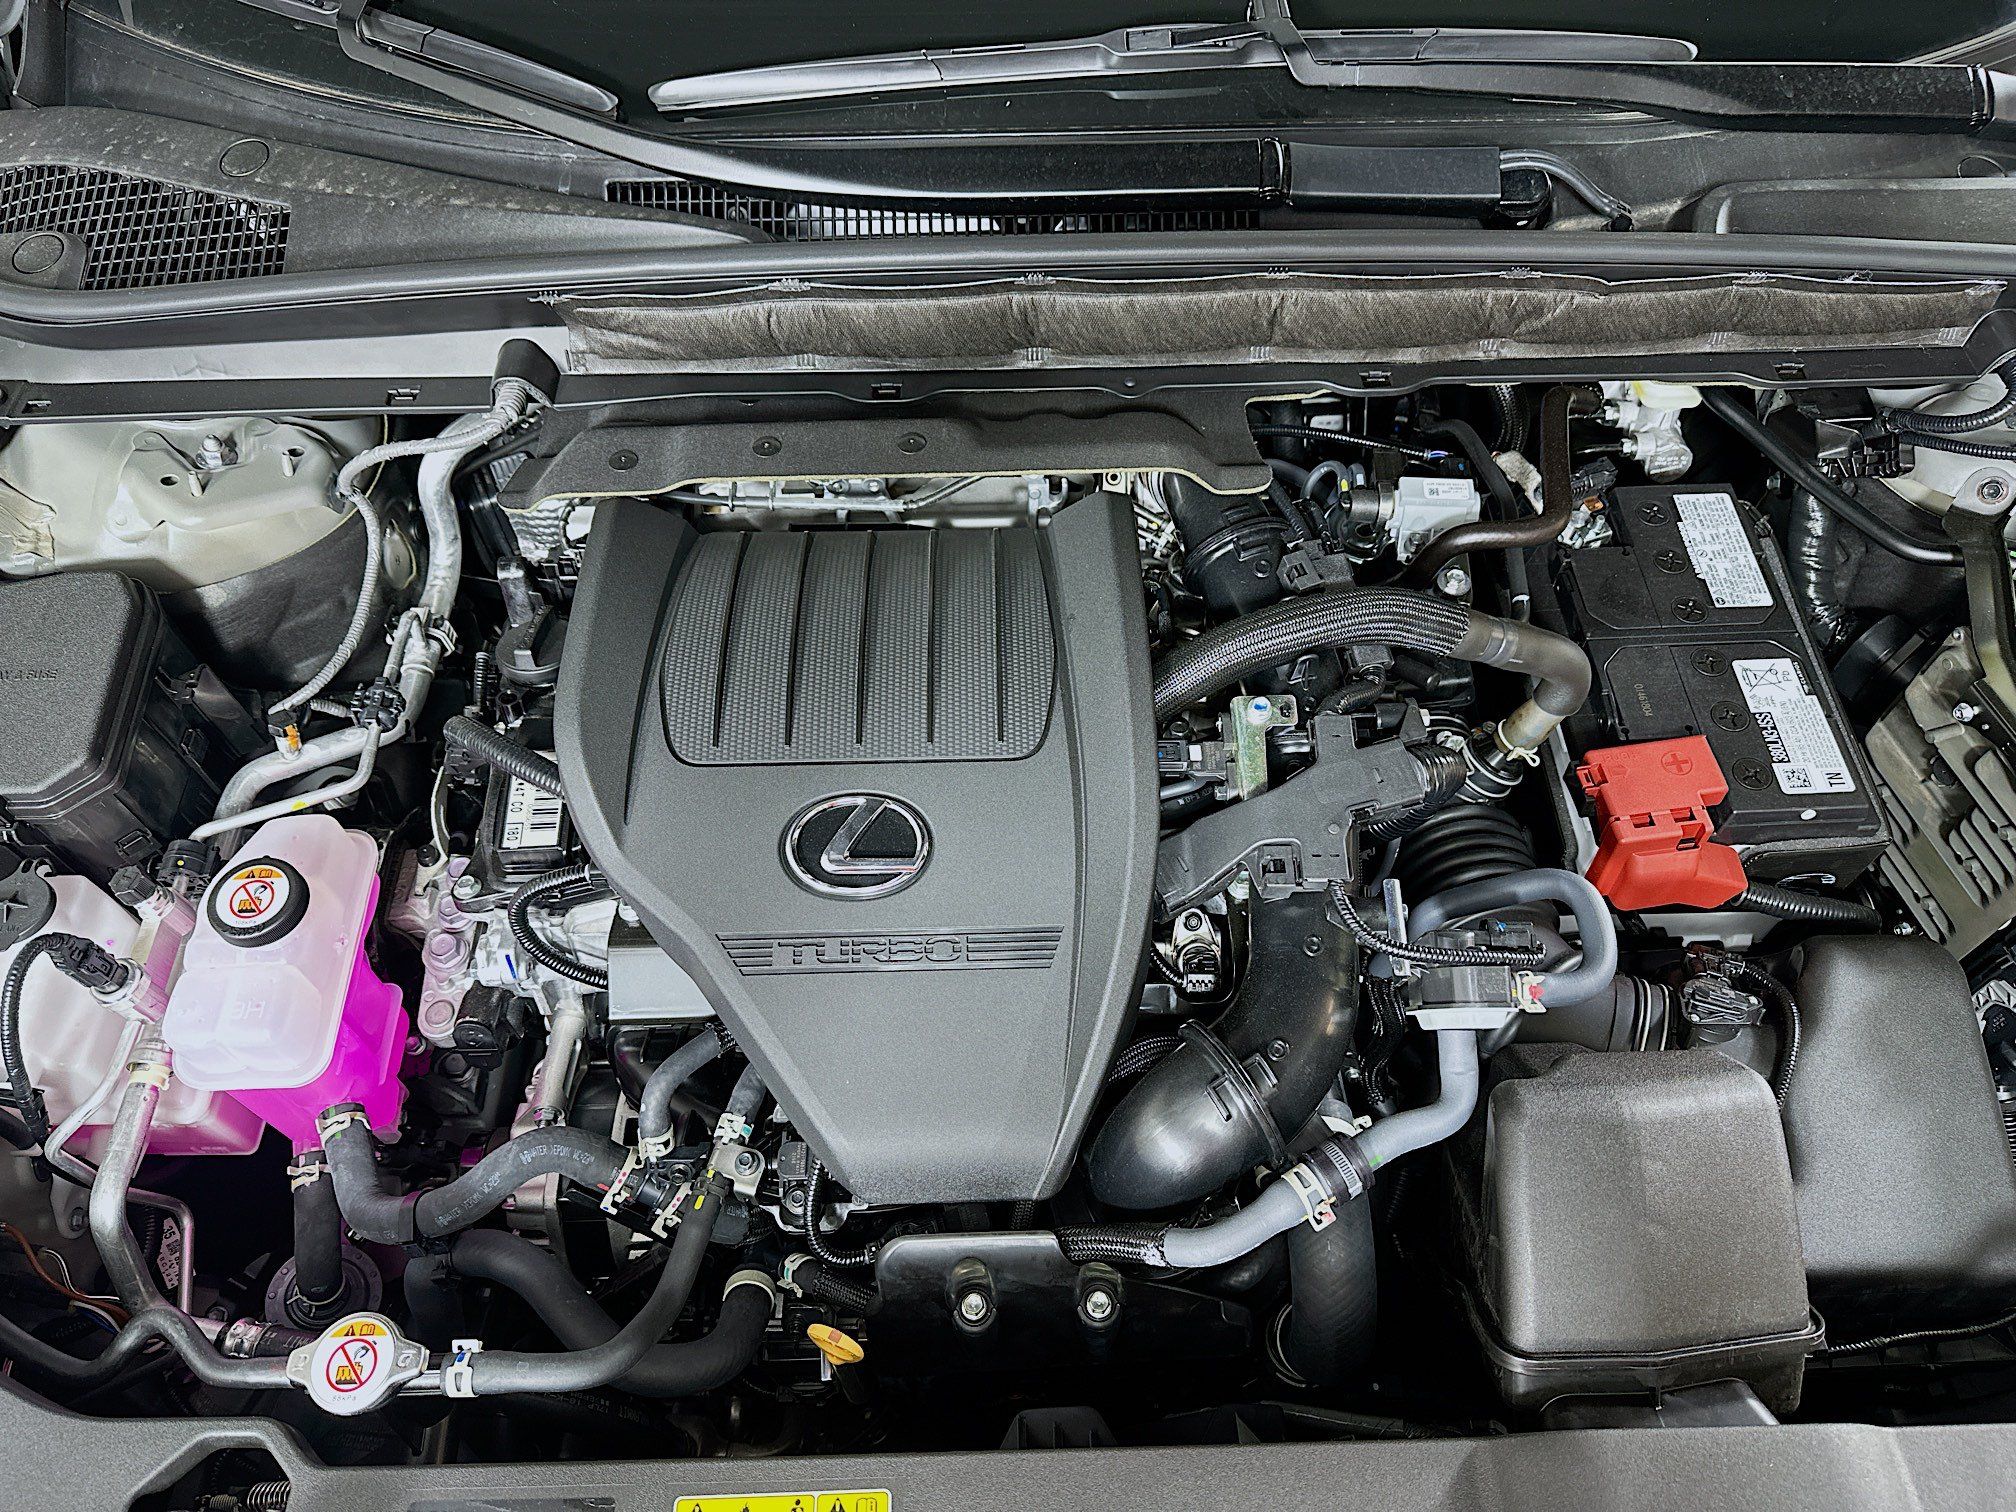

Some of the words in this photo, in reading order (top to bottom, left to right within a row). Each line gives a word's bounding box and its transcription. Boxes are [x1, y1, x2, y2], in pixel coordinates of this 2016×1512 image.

[1754, 712, 1789, 763] 380LN3-ISS
[1825, 772, 1845, 787] TN
[507, 827, 519, 841] 180
[777, 936, 962, 964] TURBO
